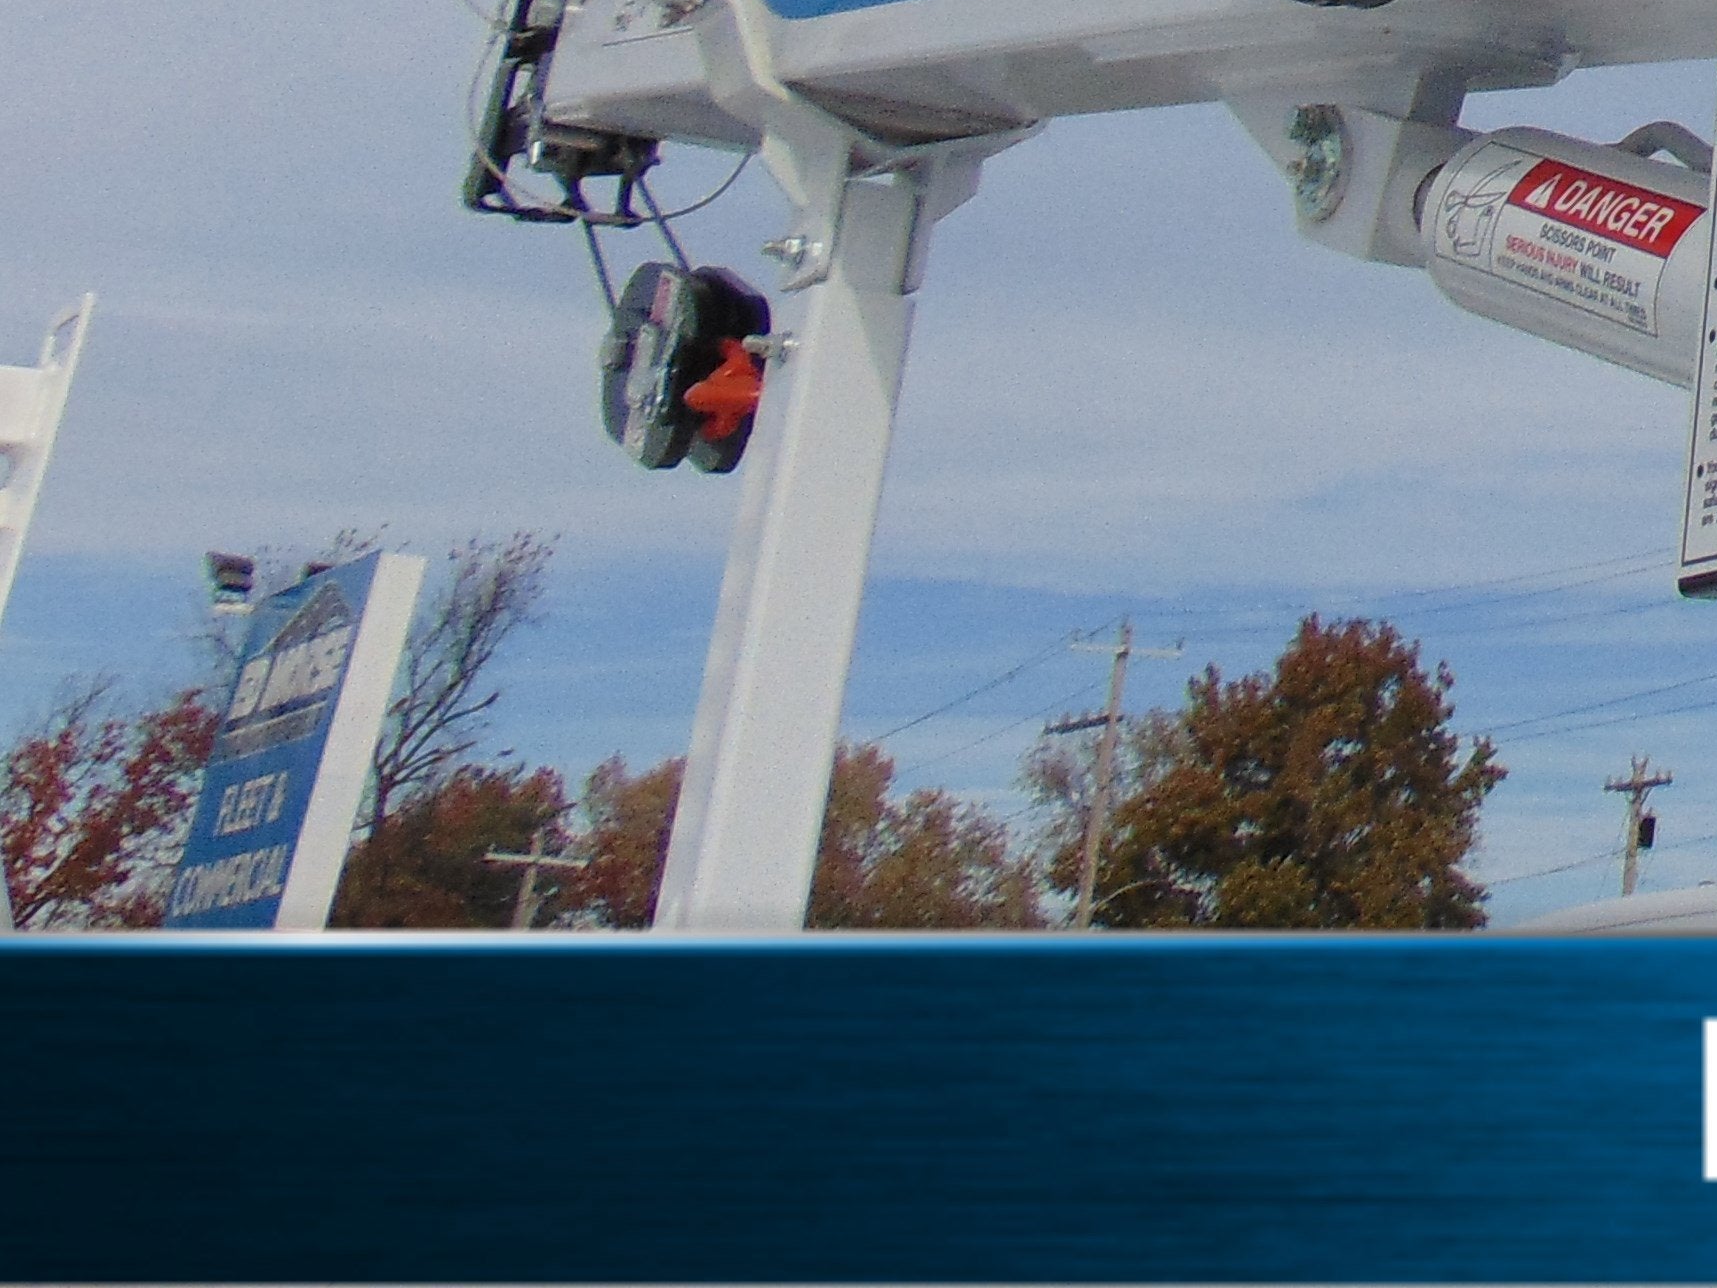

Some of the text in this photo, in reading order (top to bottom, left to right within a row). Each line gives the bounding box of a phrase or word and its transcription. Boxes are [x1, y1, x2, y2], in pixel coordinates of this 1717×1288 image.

[1554, 180, 1675, 243] DANGER
[1505, 235, 1641, 298] SERIOUS INJURY WILL RESULT
[1540, 223, 1617, 264] SCISSORS POINT
[213, 774, 274, 838] FLEET
[172, 843, 289, 919] COMMERCIAL
